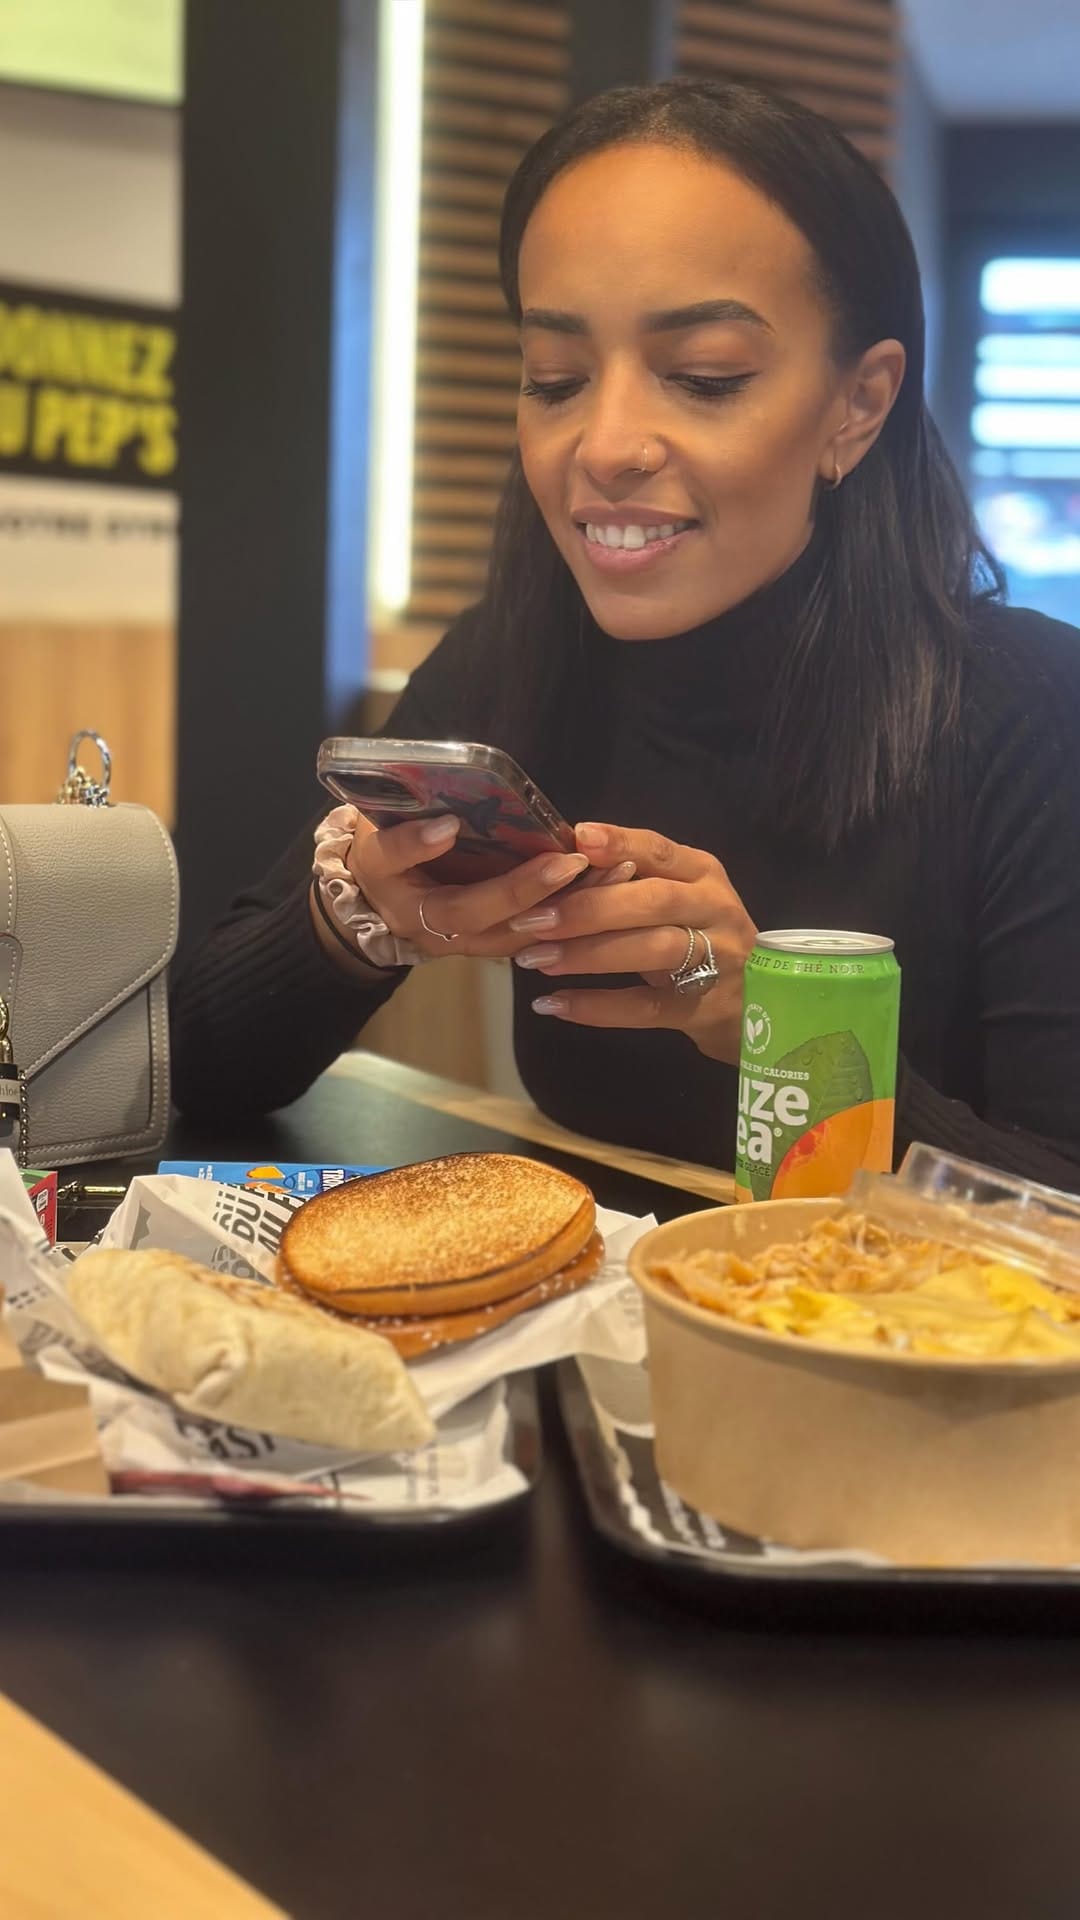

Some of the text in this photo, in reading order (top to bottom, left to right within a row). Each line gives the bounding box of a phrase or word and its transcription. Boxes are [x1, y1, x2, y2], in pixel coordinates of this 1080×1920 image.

[773, 959, 789, 970] DE
[794, 961, 823, 973] THÉ
[829, 963, 865, 974] NOIR
[763, 1067, 810, 1081] CALORIES
